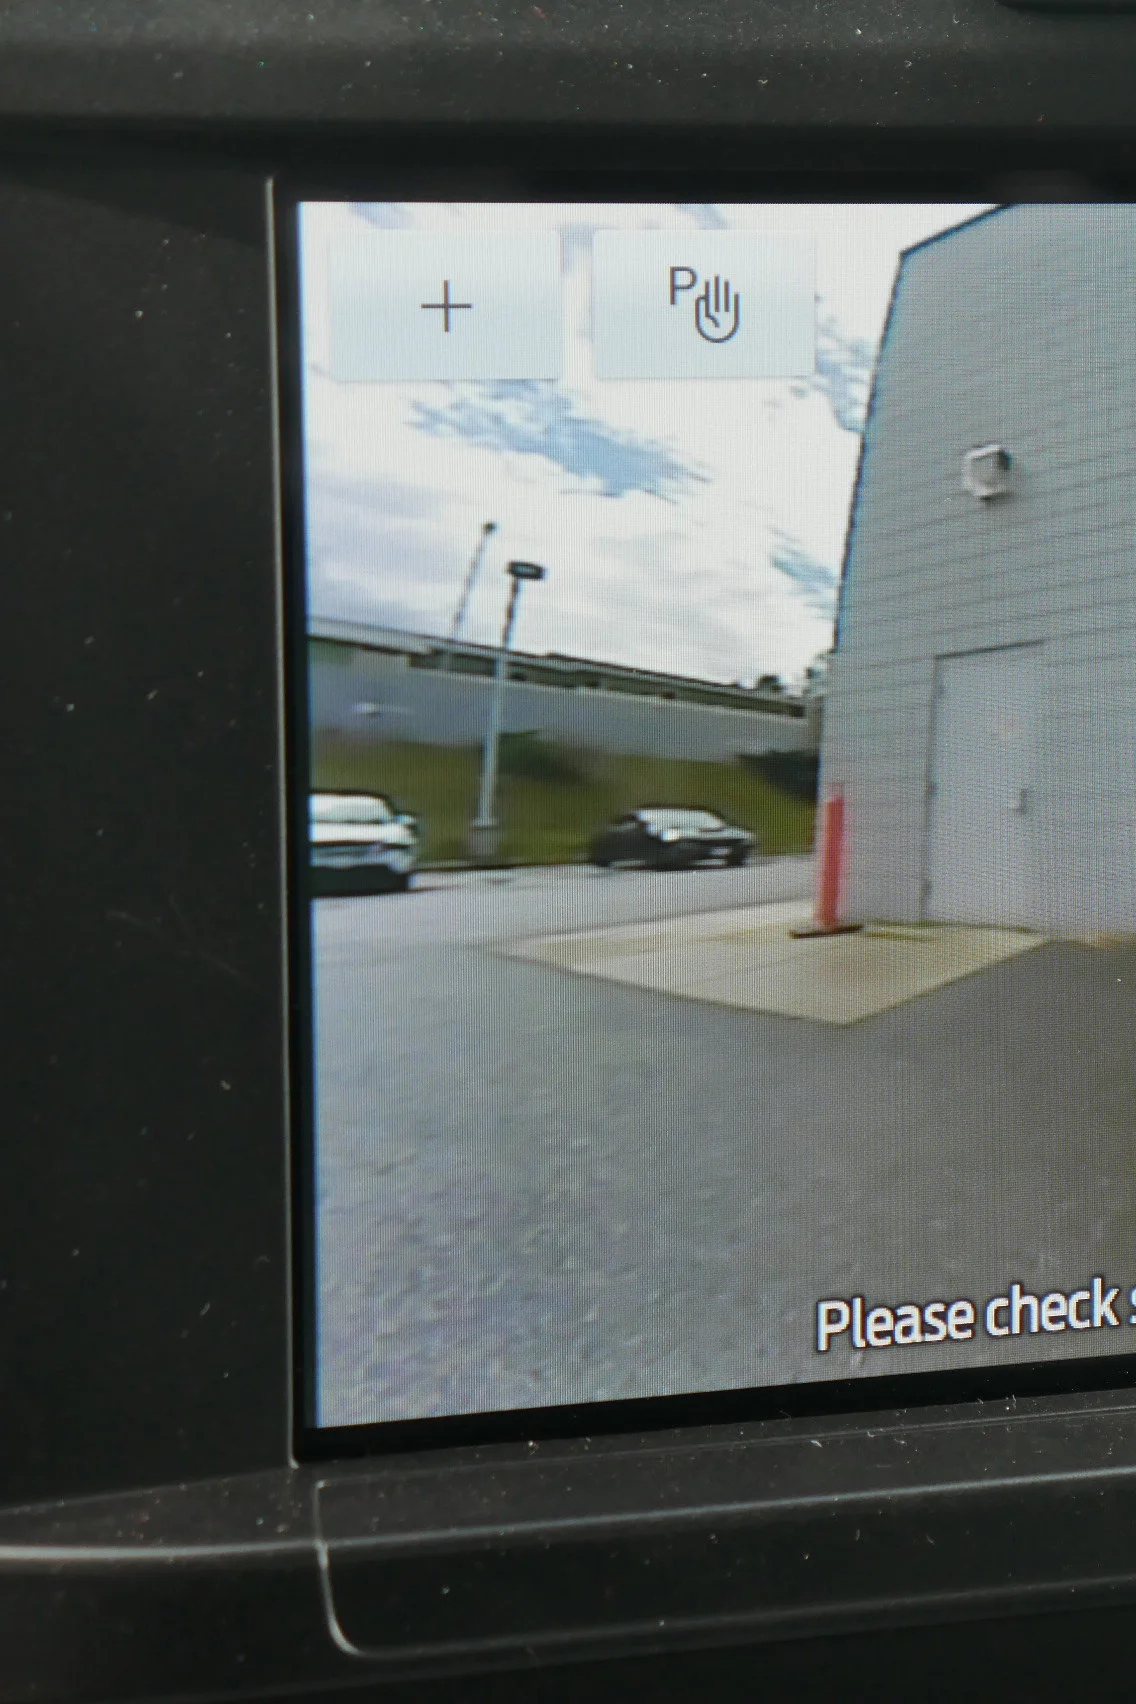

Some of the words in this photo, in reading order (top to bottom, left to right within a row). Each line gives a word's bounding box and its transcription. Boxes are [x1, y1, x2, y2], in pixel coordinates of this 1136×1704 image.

[669, 265, 697, 306] P
[816, 1296, 975, 1352] Please
[986, 1276, 1120, 1336] check
